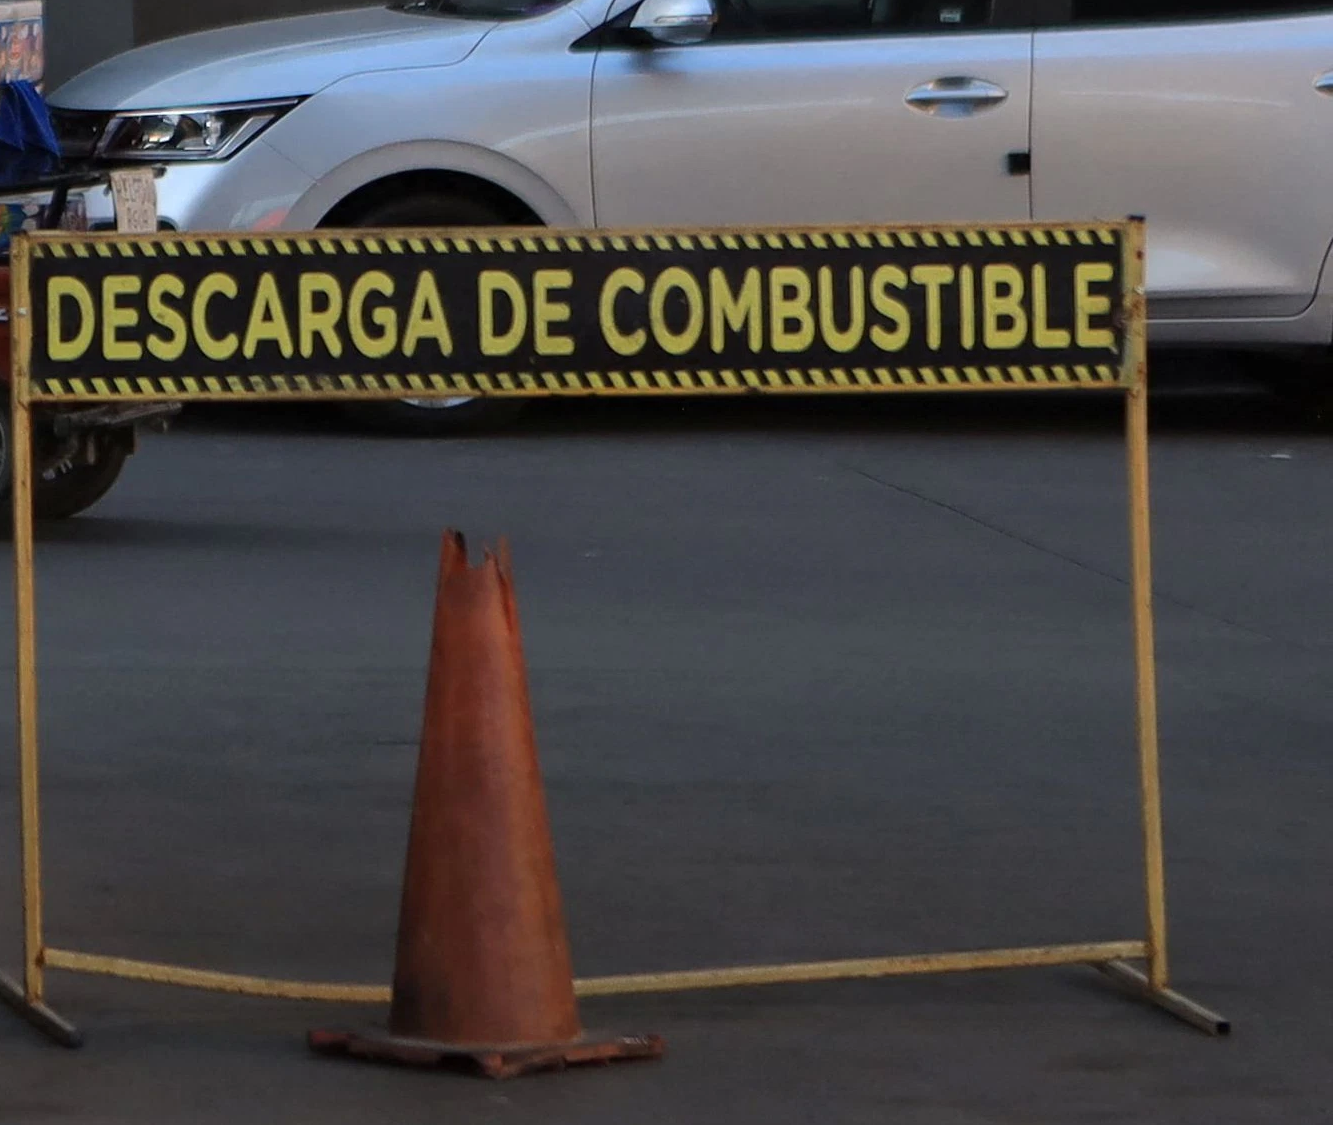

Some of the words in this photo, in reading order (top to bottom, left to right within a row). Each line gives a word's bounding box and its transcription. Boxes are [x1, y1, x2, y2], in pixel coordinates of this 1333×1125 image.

[46, 270, 454, 361] DESCARGA
[477, 269, 576, 358] DE
[598, 262, 1116, 356] COMBUSTIBLE
